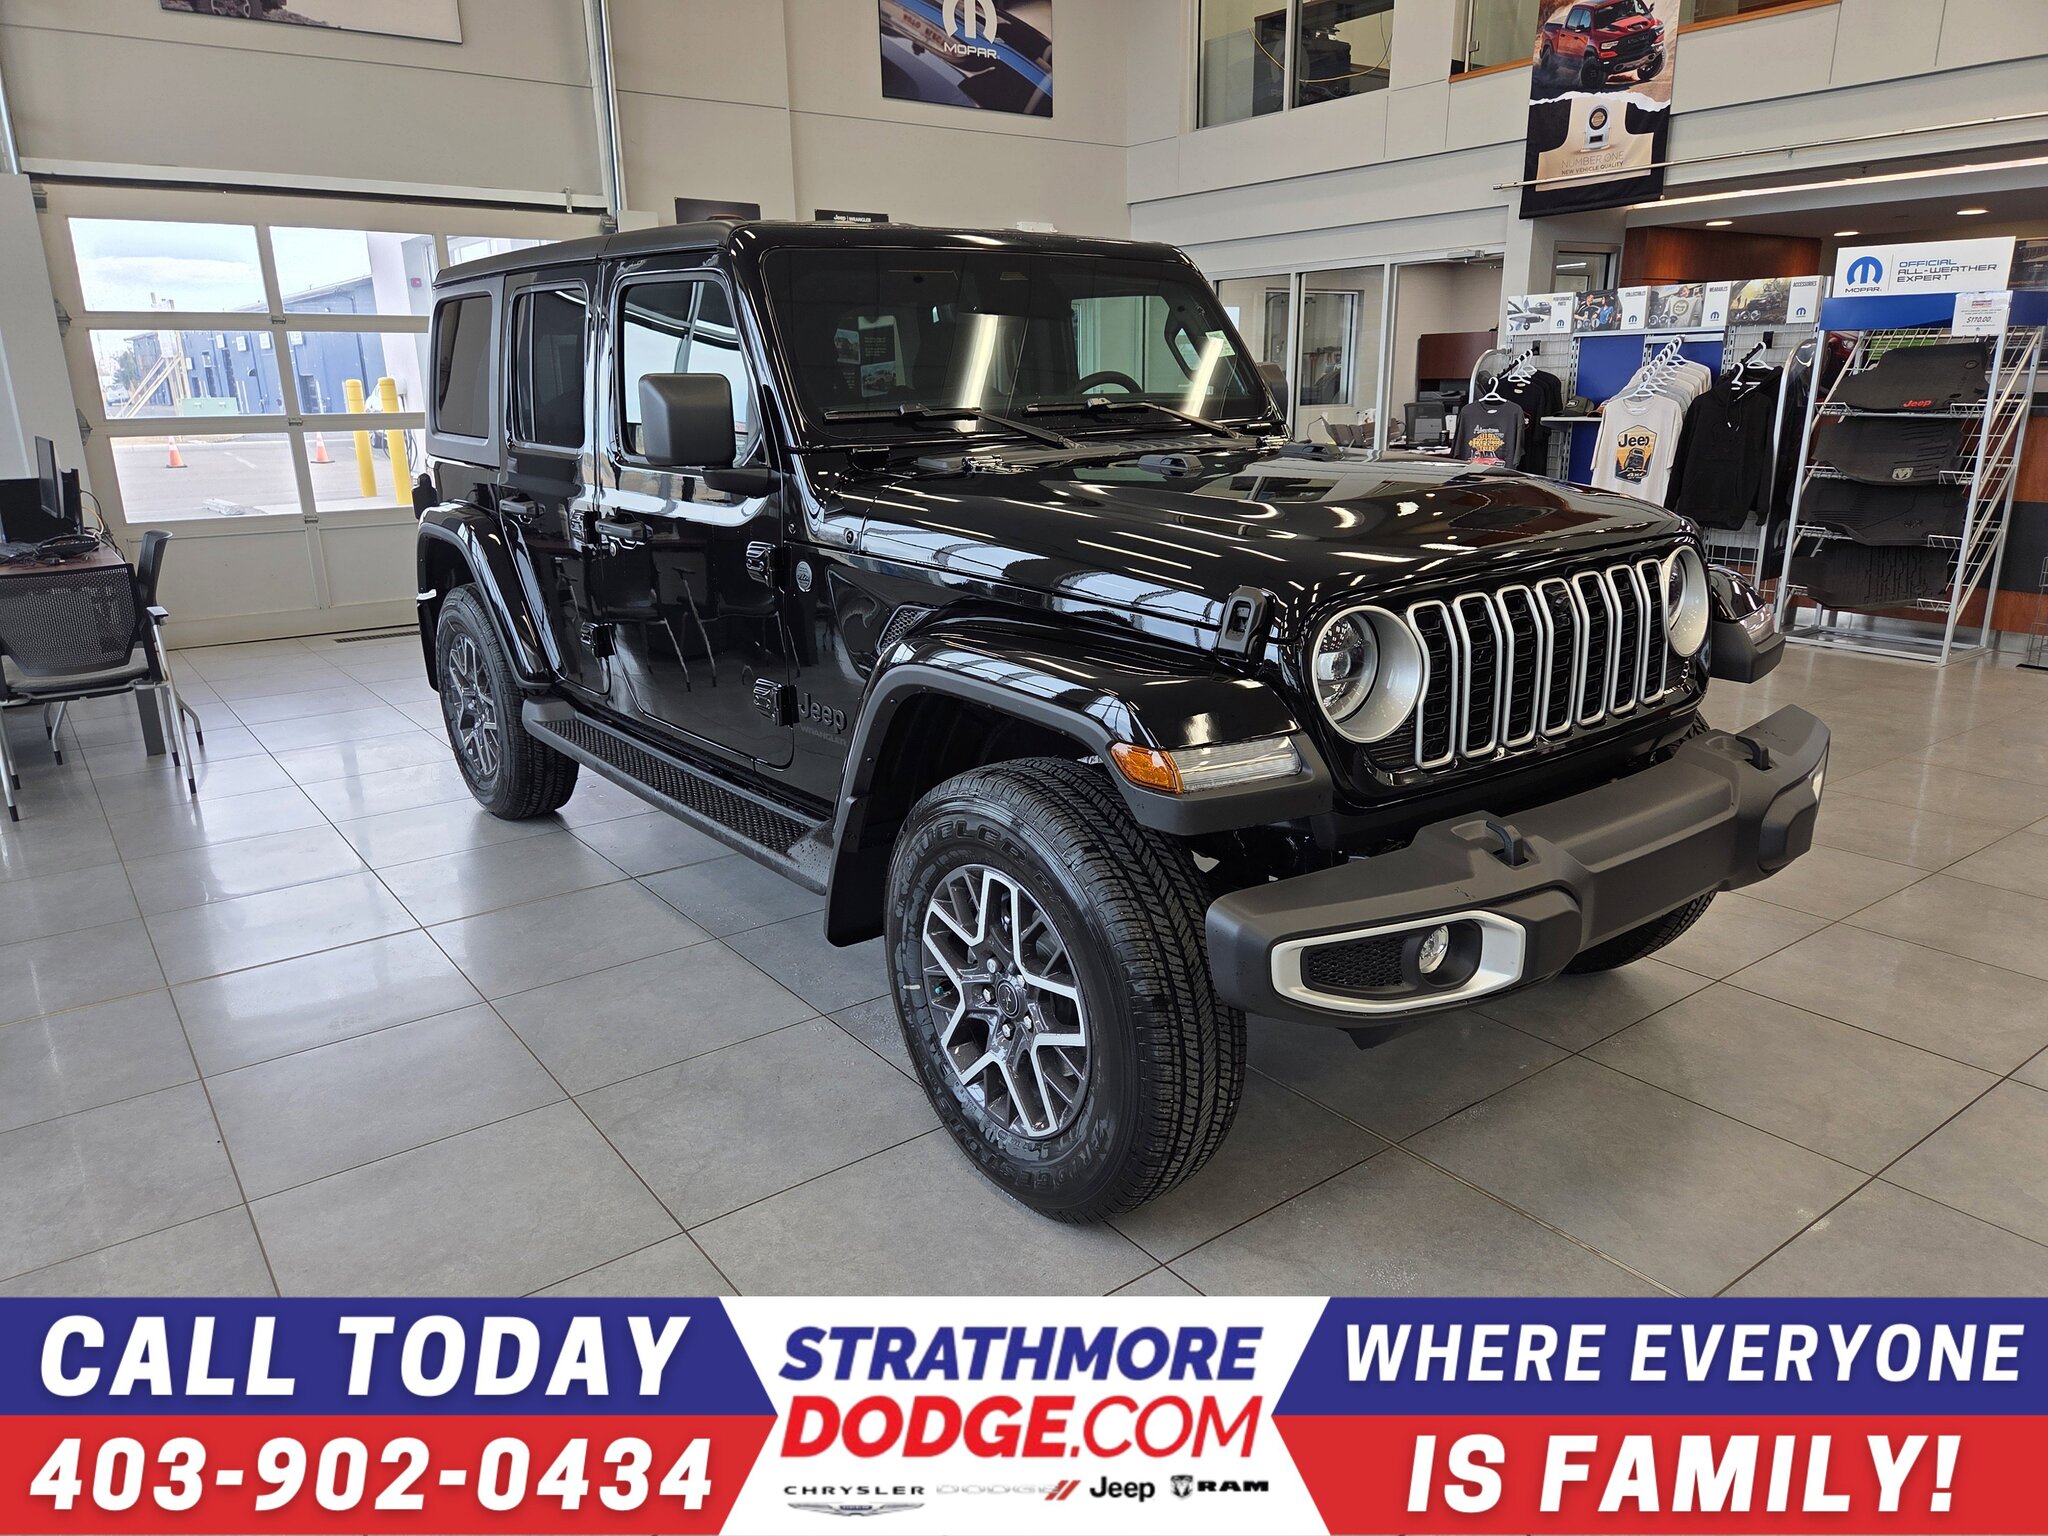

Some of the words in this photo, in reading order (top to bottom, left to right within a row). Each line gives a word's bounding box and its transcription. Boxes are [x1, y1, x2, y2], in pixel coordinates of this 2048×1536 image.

[943, 42, 998, 59] MOPAR
[1561, 155, 1603, 168] NUMBER
[1604, 151, 1625, 162] ONE
[1575, 165, 1599, 173] VEHICLE
[1599, 161, 1624, 169] QUALITY
[1897, 264, 1997, 275] ALL-WEATHER
[1899, 259, 1957, 268] OFFICIAL
[1896, 274, 1951, 283] EXPERT
[1903, 399, 1932, 408] Jeep
[801, 692, 847, 734] Jeep
[801, 725, 847, 747] WRANGLER
